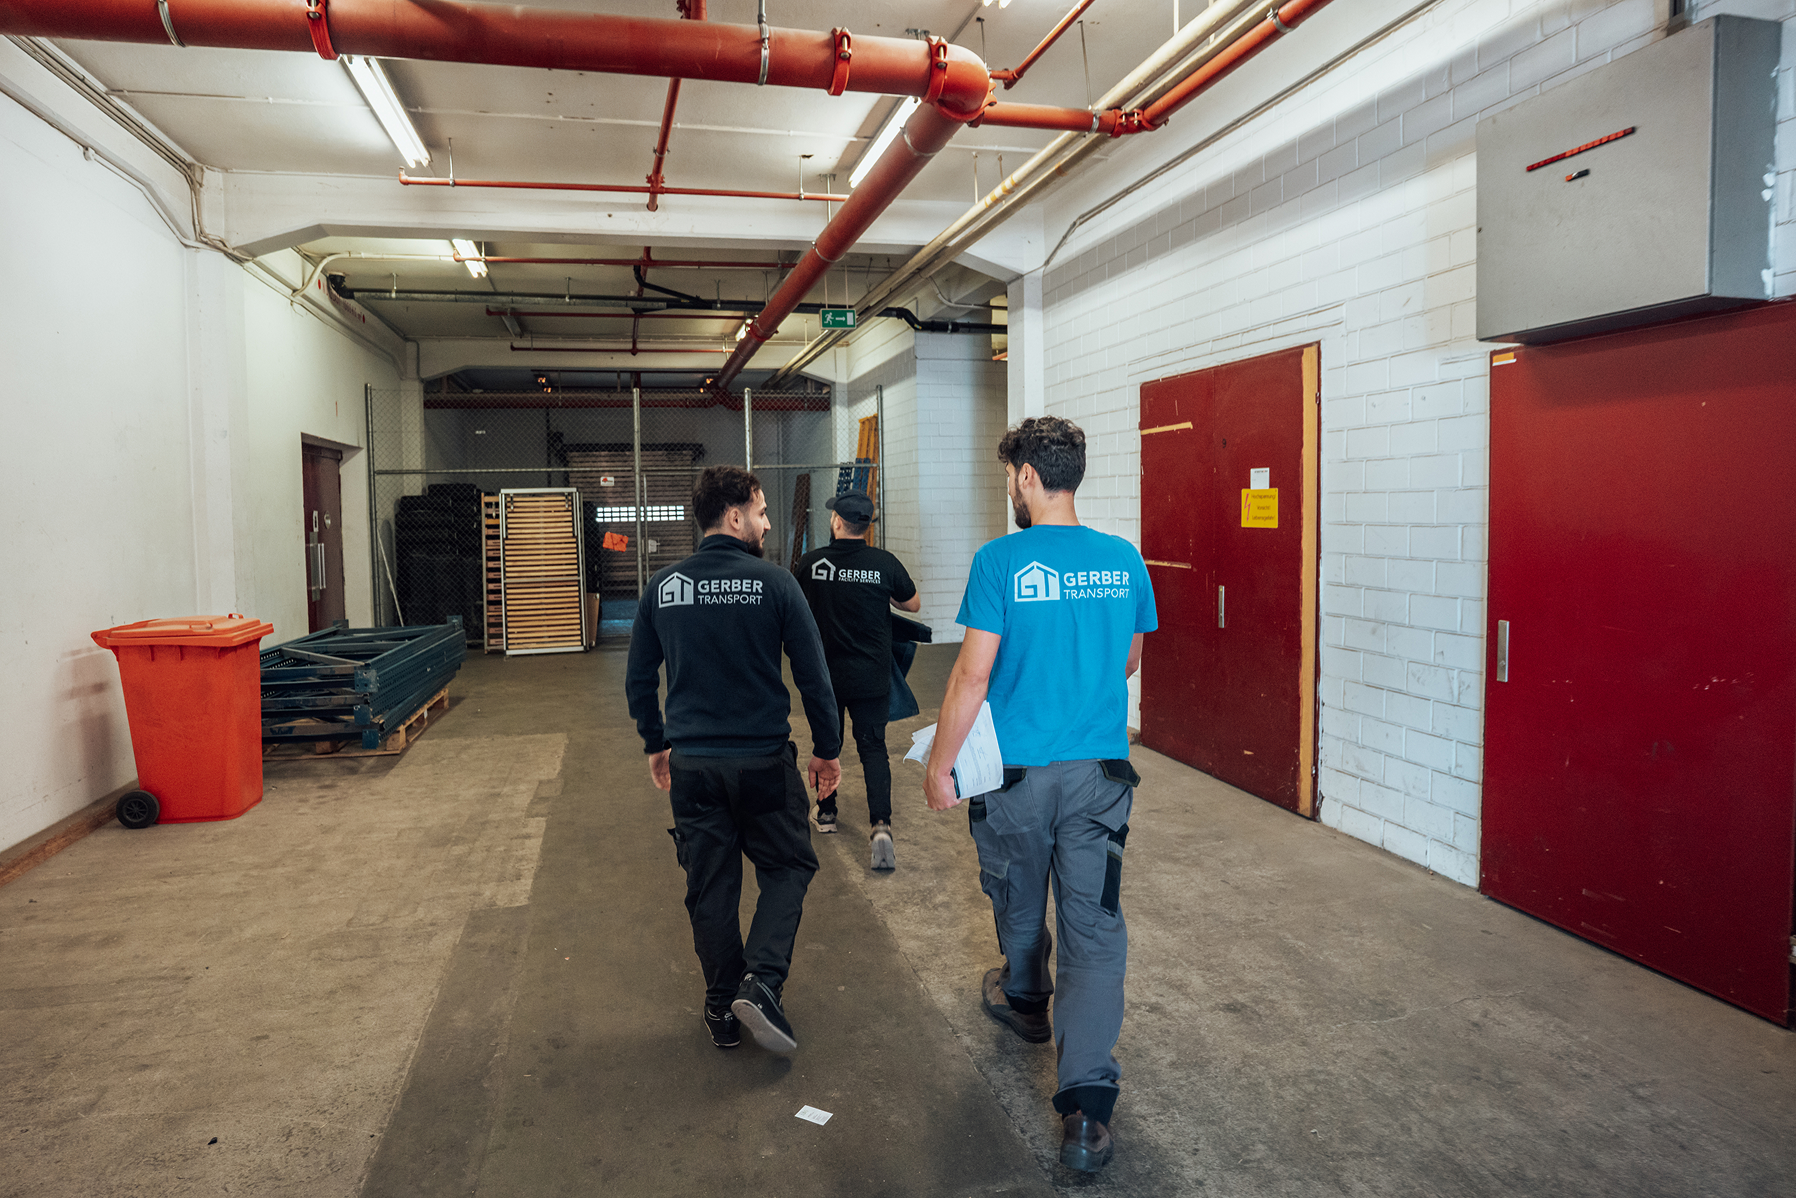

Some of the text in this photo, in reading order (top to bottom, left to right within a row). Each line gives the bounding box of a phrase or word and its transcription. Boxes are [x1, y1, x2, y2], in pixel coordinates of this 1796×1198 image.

[838, 569, 881, 580] GERBER
[1063, 571, 1129, 586] GERBER
[697, 579, 763, 593] GERBER
[1063, 588, 1130, 599] TRANSPORT
[697, 594, 763, 605] TRANSPORT
